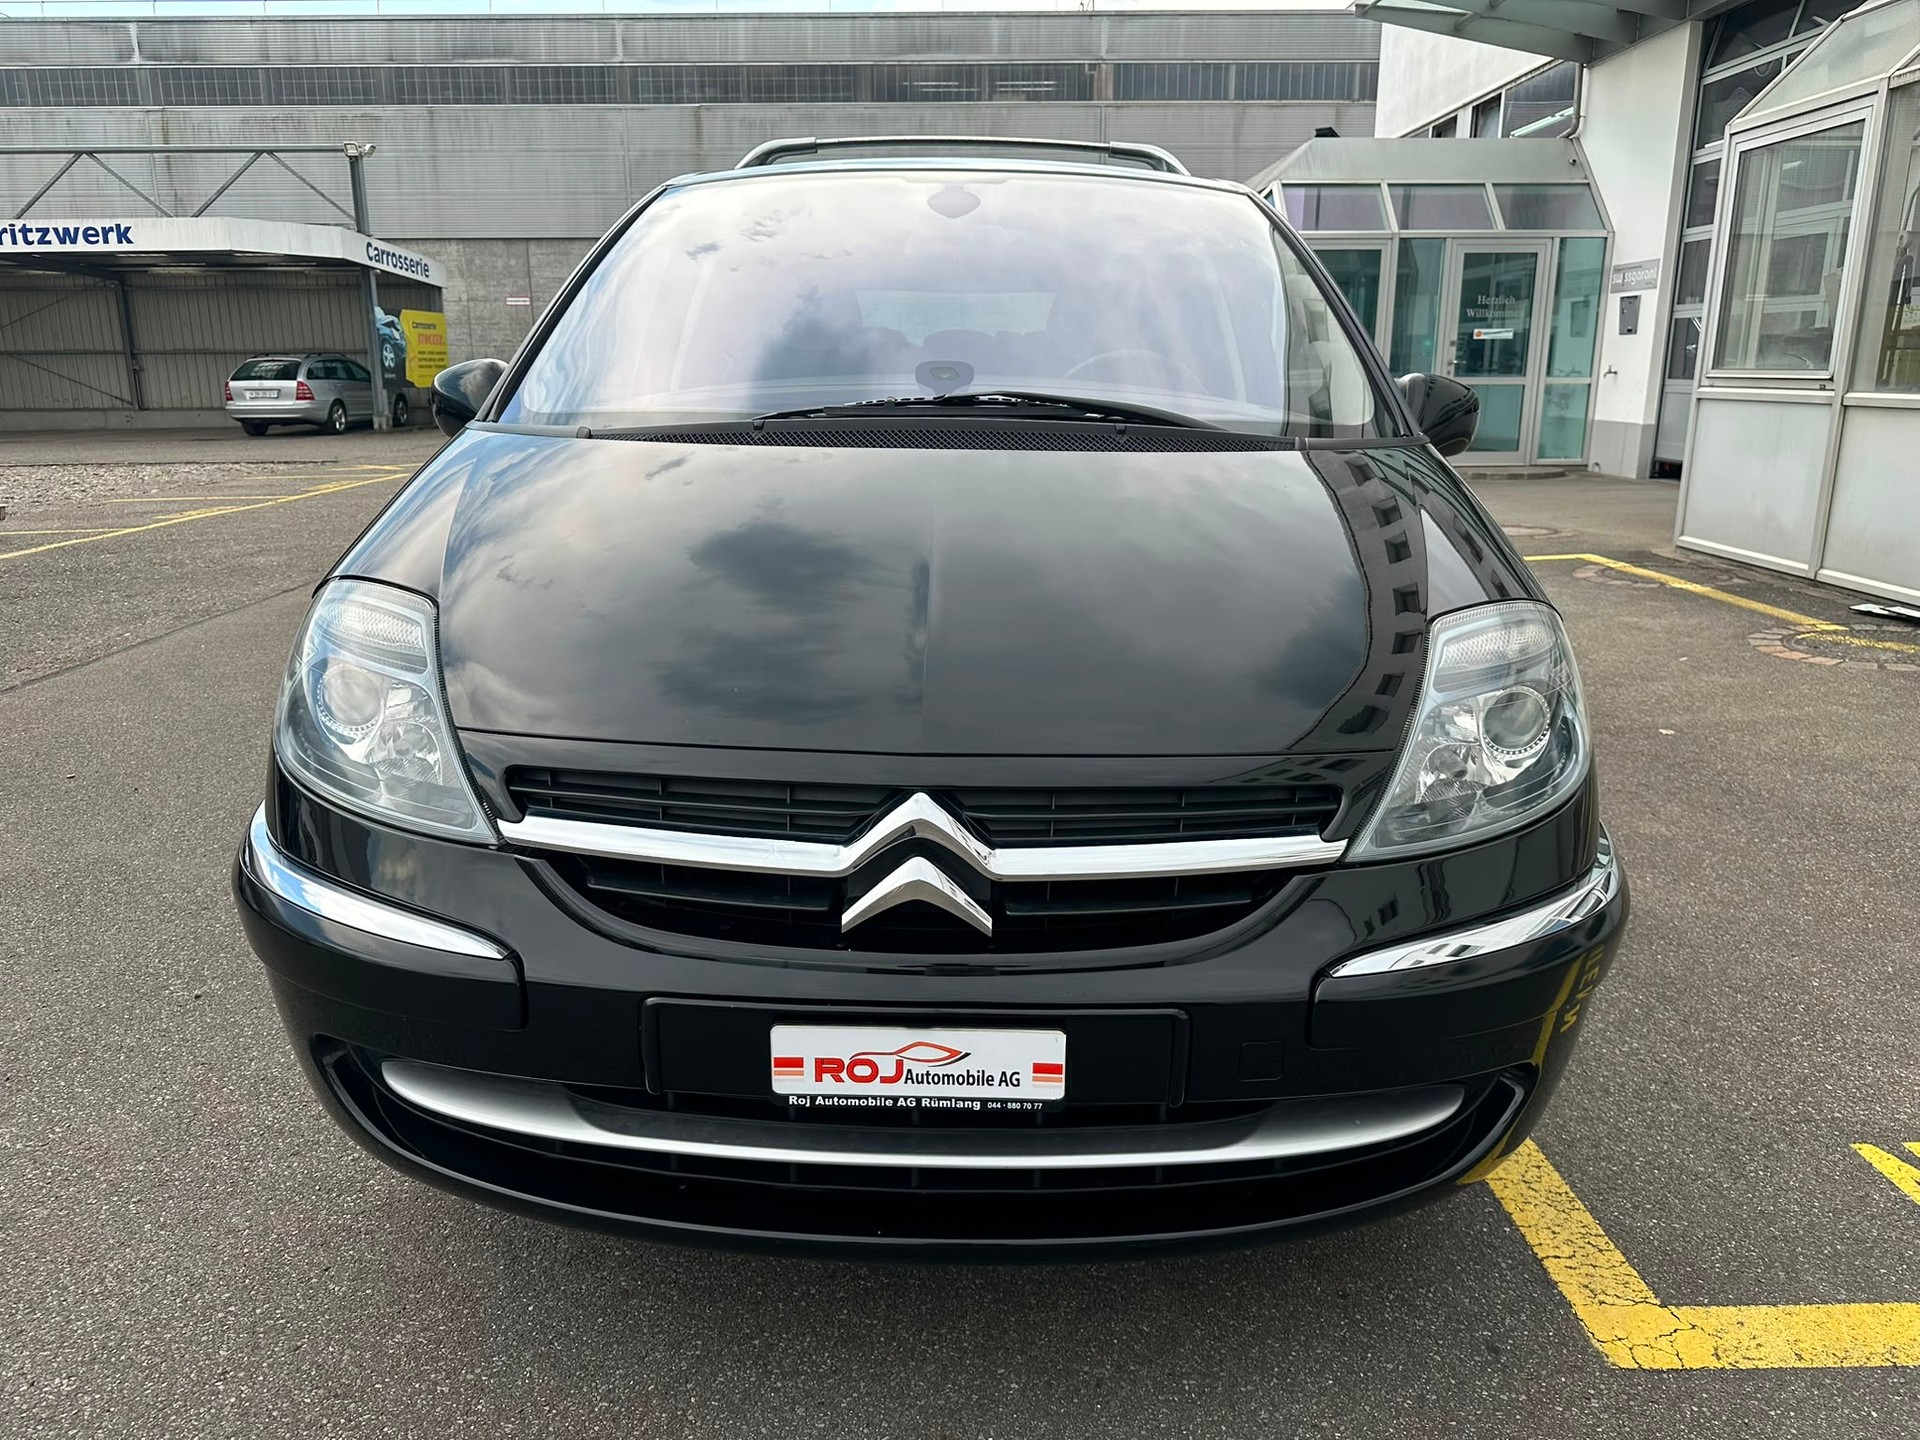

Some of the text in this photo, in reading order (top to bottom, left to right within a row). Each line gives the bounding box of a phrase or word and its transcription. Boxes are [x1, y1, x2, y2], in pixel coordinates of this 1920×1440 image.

[366, 241, 430, 278] Carrosserie
[814, 1057, 1021, 1088] ROJ Automobile AG
[788, 1095, 810, 1107] Roj
[815, 1096, 894, 1107] Automobile
[897, 1097, 917, 1107] AG
[921, 1098, 981, 1110] Rümlang
